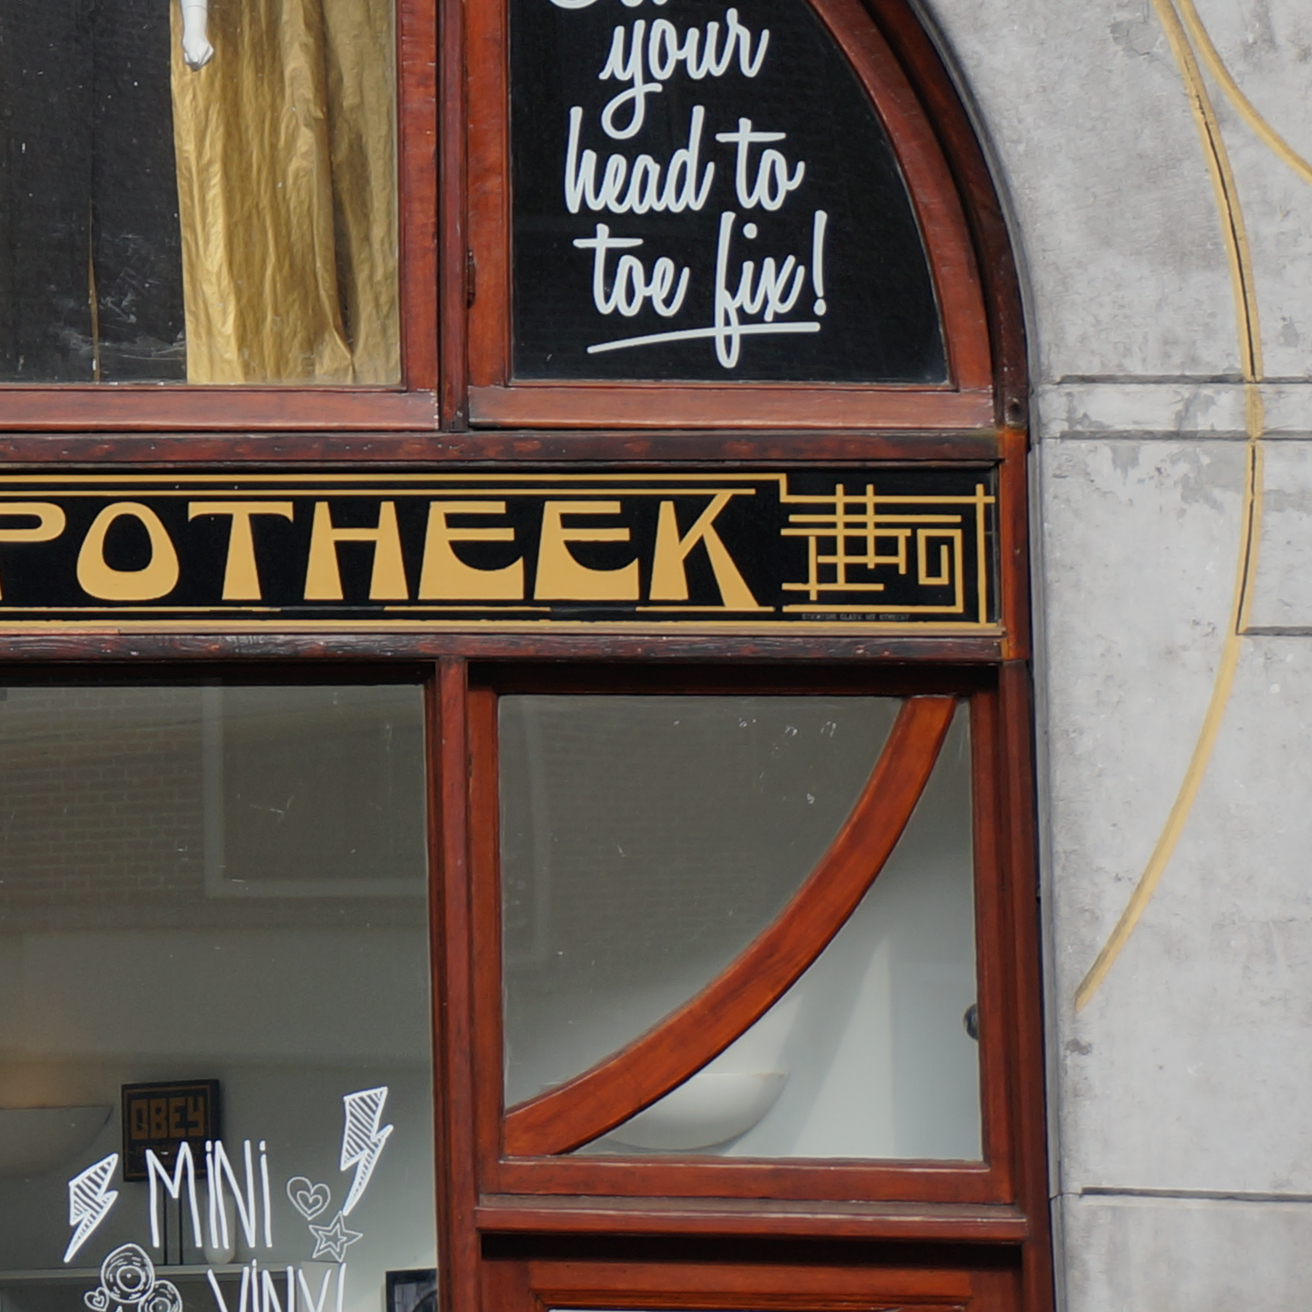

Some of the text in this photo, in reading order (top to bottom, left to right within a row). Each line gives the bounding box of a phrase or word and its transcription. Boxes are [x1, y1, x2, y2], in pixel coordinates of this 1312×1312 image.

[598, 7, 770, 140] your
[564, 105, 806, 214] head to
[572, 210, 828, 369] toe fix!
[130, 1095, 205, 1140] OBEY
